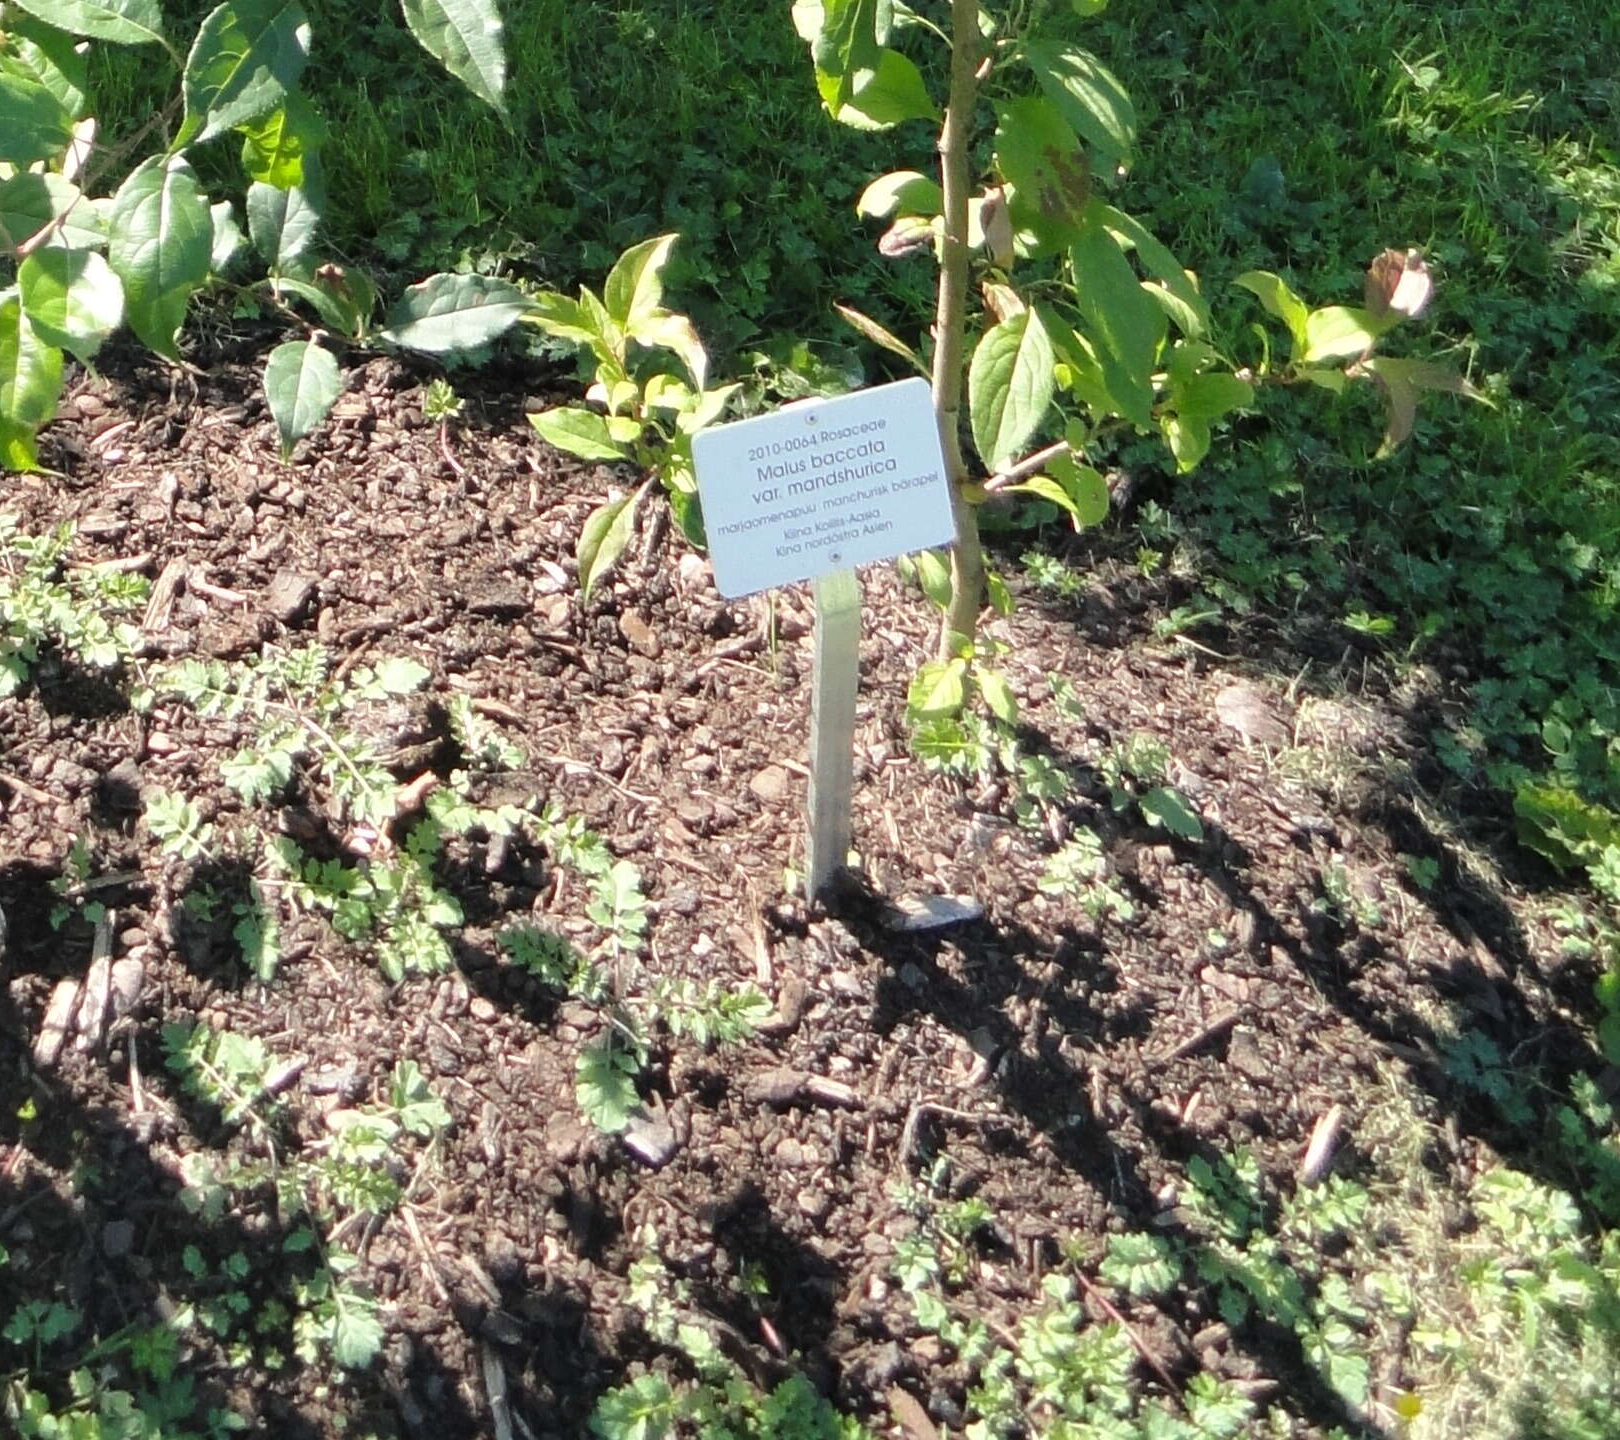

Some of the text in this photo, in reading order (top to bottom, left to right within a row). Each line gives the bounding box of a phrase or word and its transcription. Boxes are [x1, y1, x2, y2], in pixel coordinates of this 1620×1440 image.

[748, 419, 886, 461] 2010-0064 Rosaceae
[757, 439, 885, 482] Malus baccata
[752, 457, 897, 504] var. mandshurica
